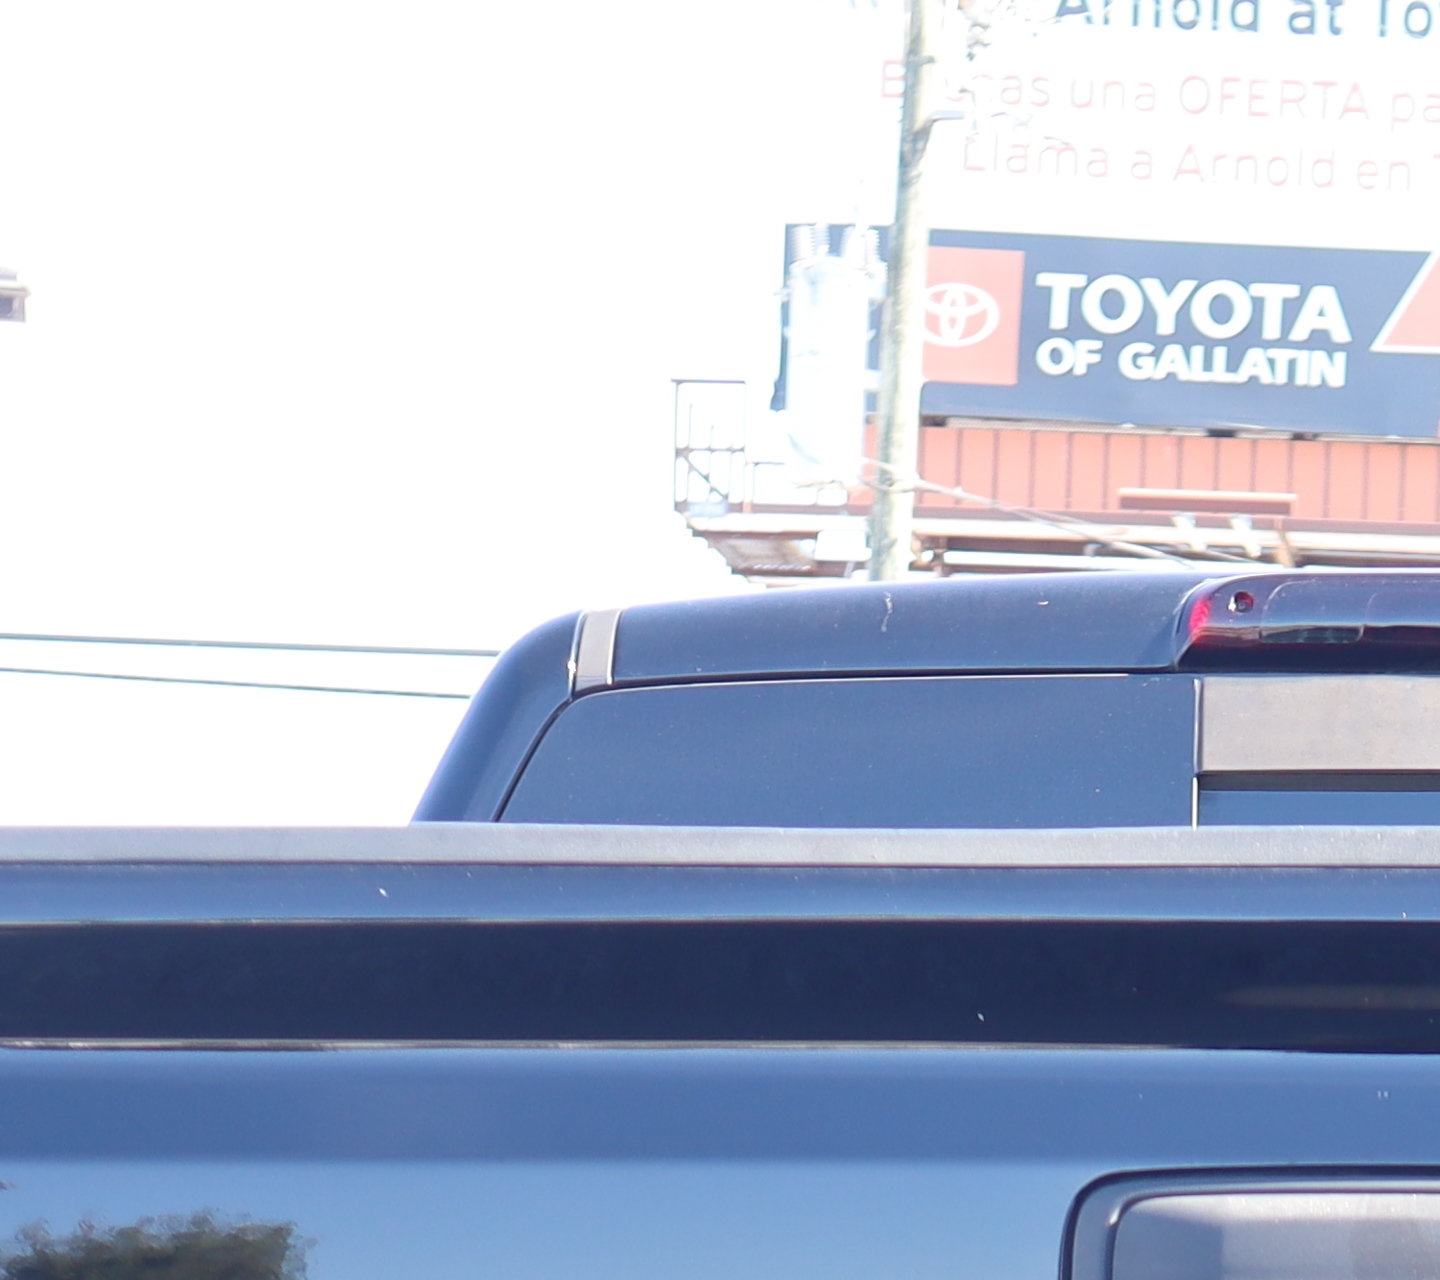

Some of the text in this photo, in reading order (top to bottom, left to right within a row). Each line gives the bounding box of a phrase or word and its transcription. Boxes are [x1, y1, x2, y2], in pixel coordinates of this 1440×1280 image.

[1287, 0, 1344, 35] at
[1070, 77, 1157, 112] una
[1178, 75, 1372, 121] OFERTA
[962, 132, 1110, 179] Llama
[1130, 147, 1155, 182] a
[1172, 143, 1337, 190] Arnold
[1356, 158, 1412, 191] en
[1035, 271, 1353, 345] TOYOTA
[1035, 336, 1348, 389] OF GALLATIN
